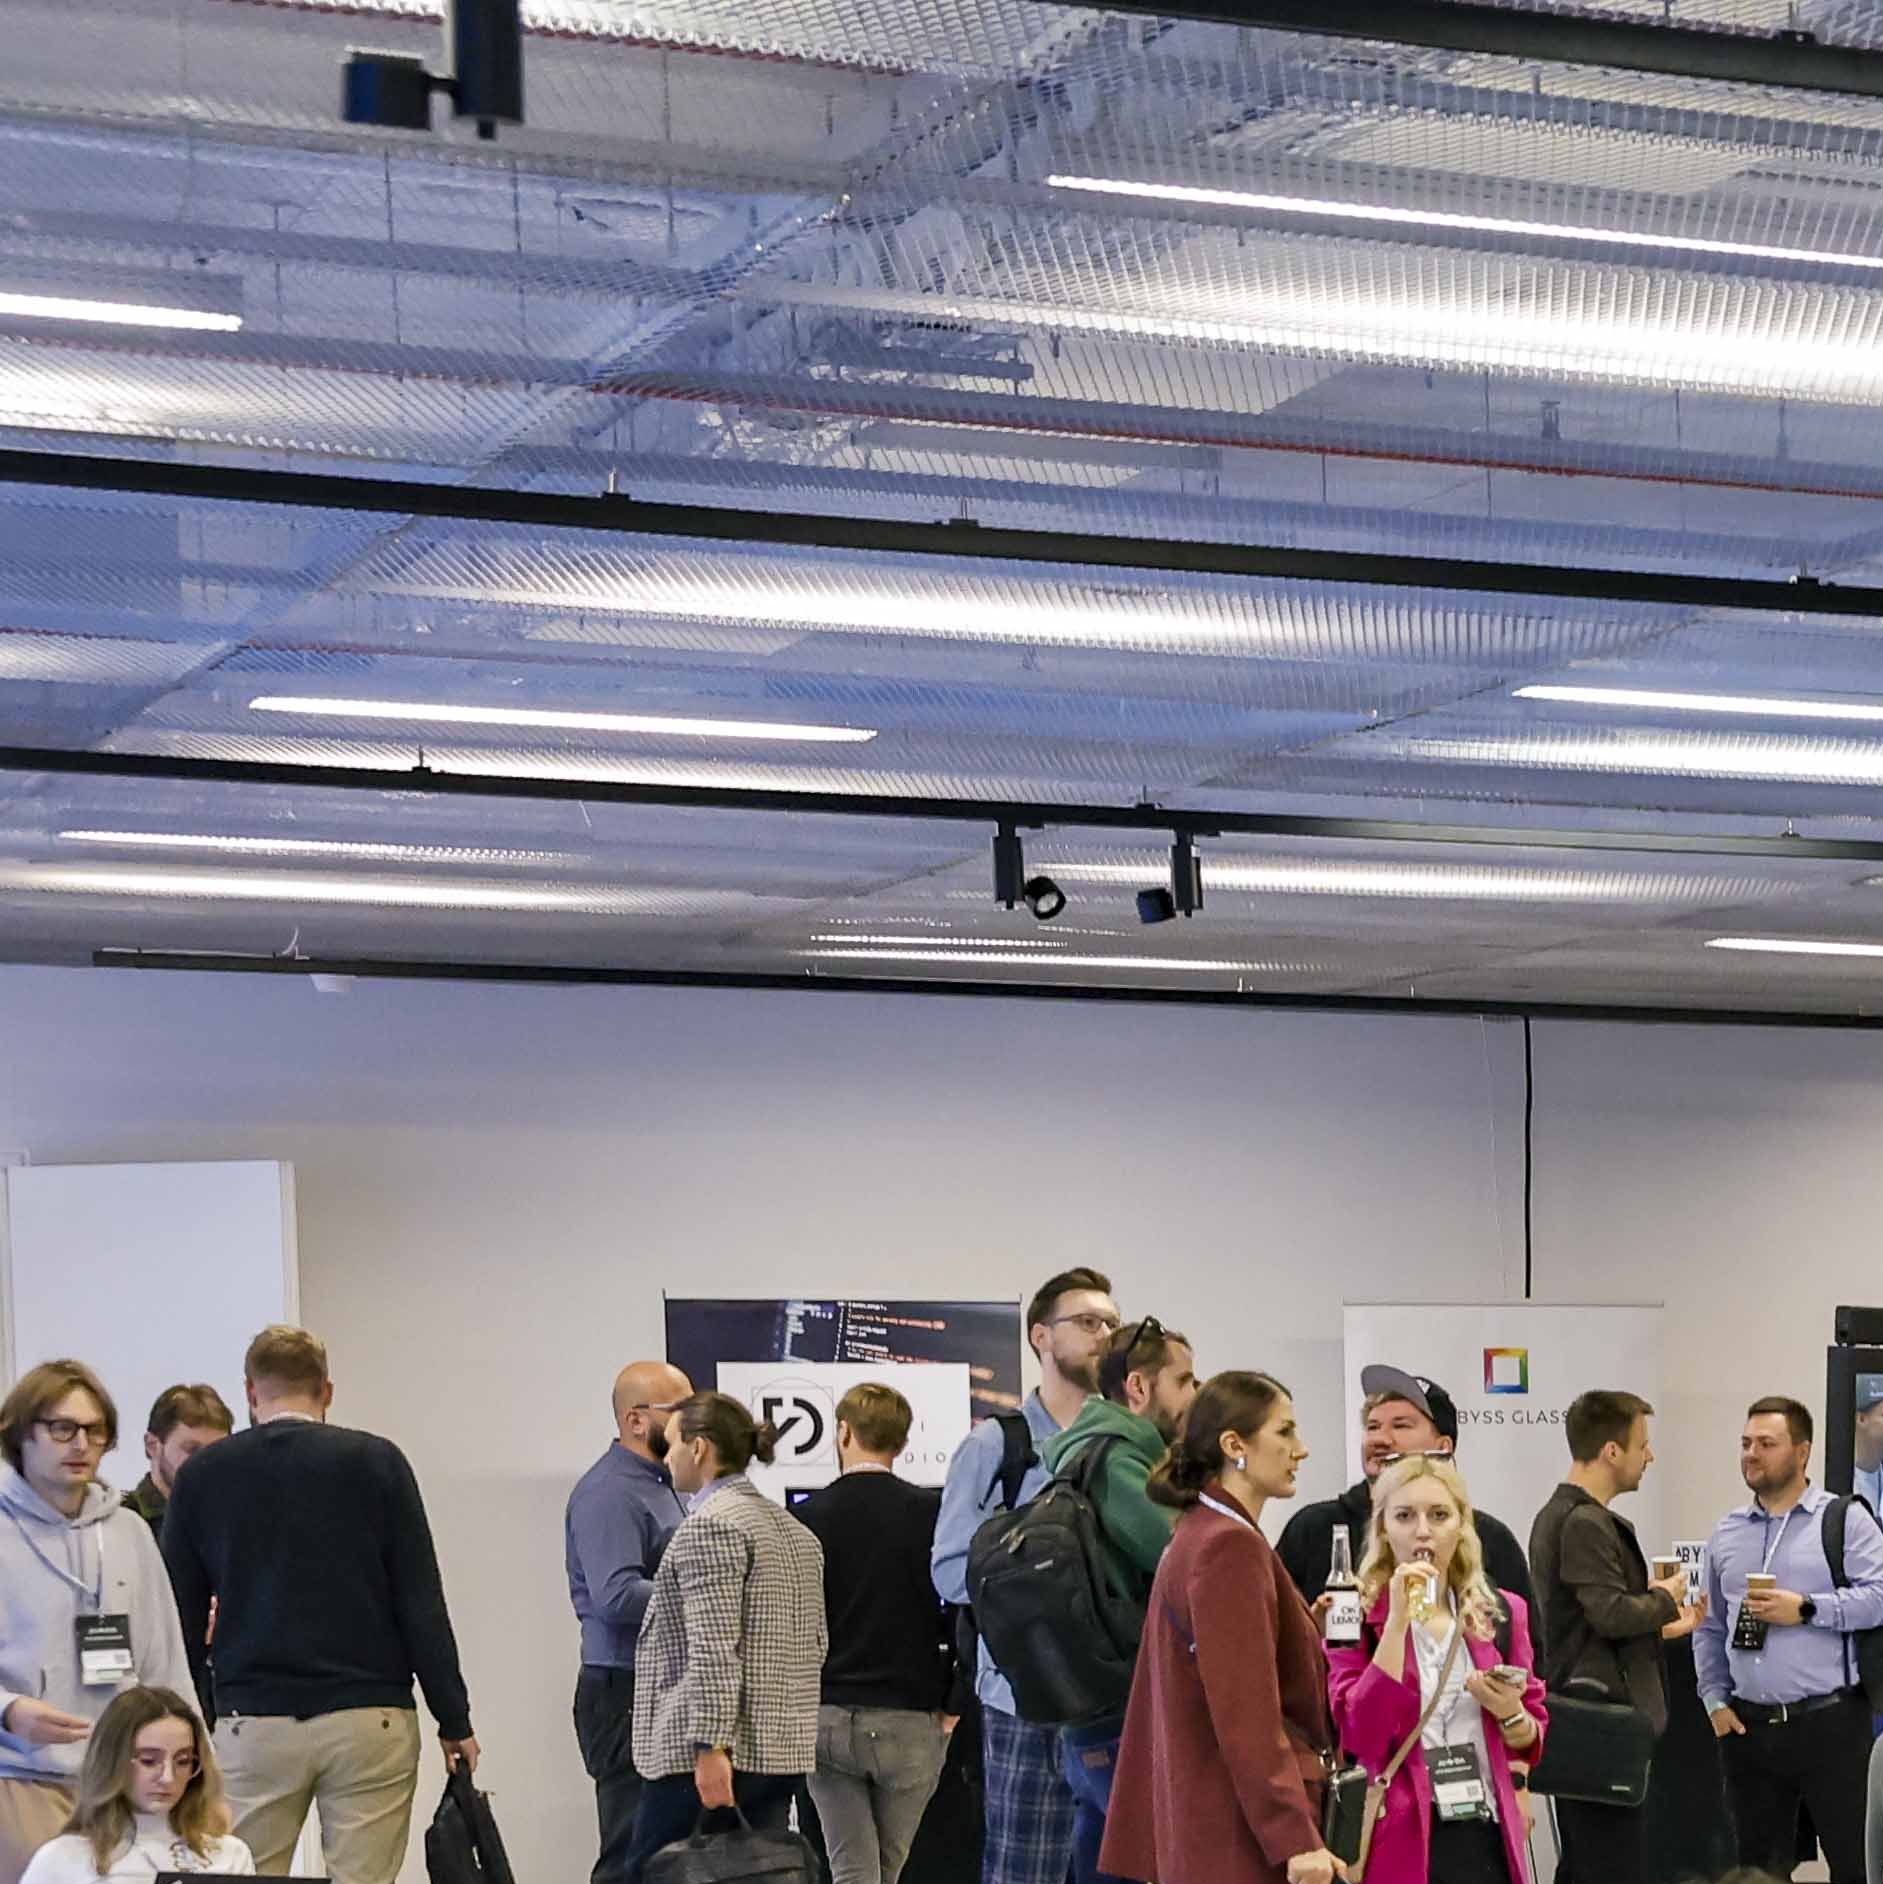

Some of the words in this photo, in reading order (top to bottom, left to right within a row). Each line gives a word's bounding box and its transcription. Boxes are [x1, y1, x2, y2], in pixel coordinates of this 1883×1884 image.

[1456, 1410, 1505, 1425] BYSS
[1511, 1410, 1569, 1425] GLASS
[904, 1452, 946, 1464] DIO
